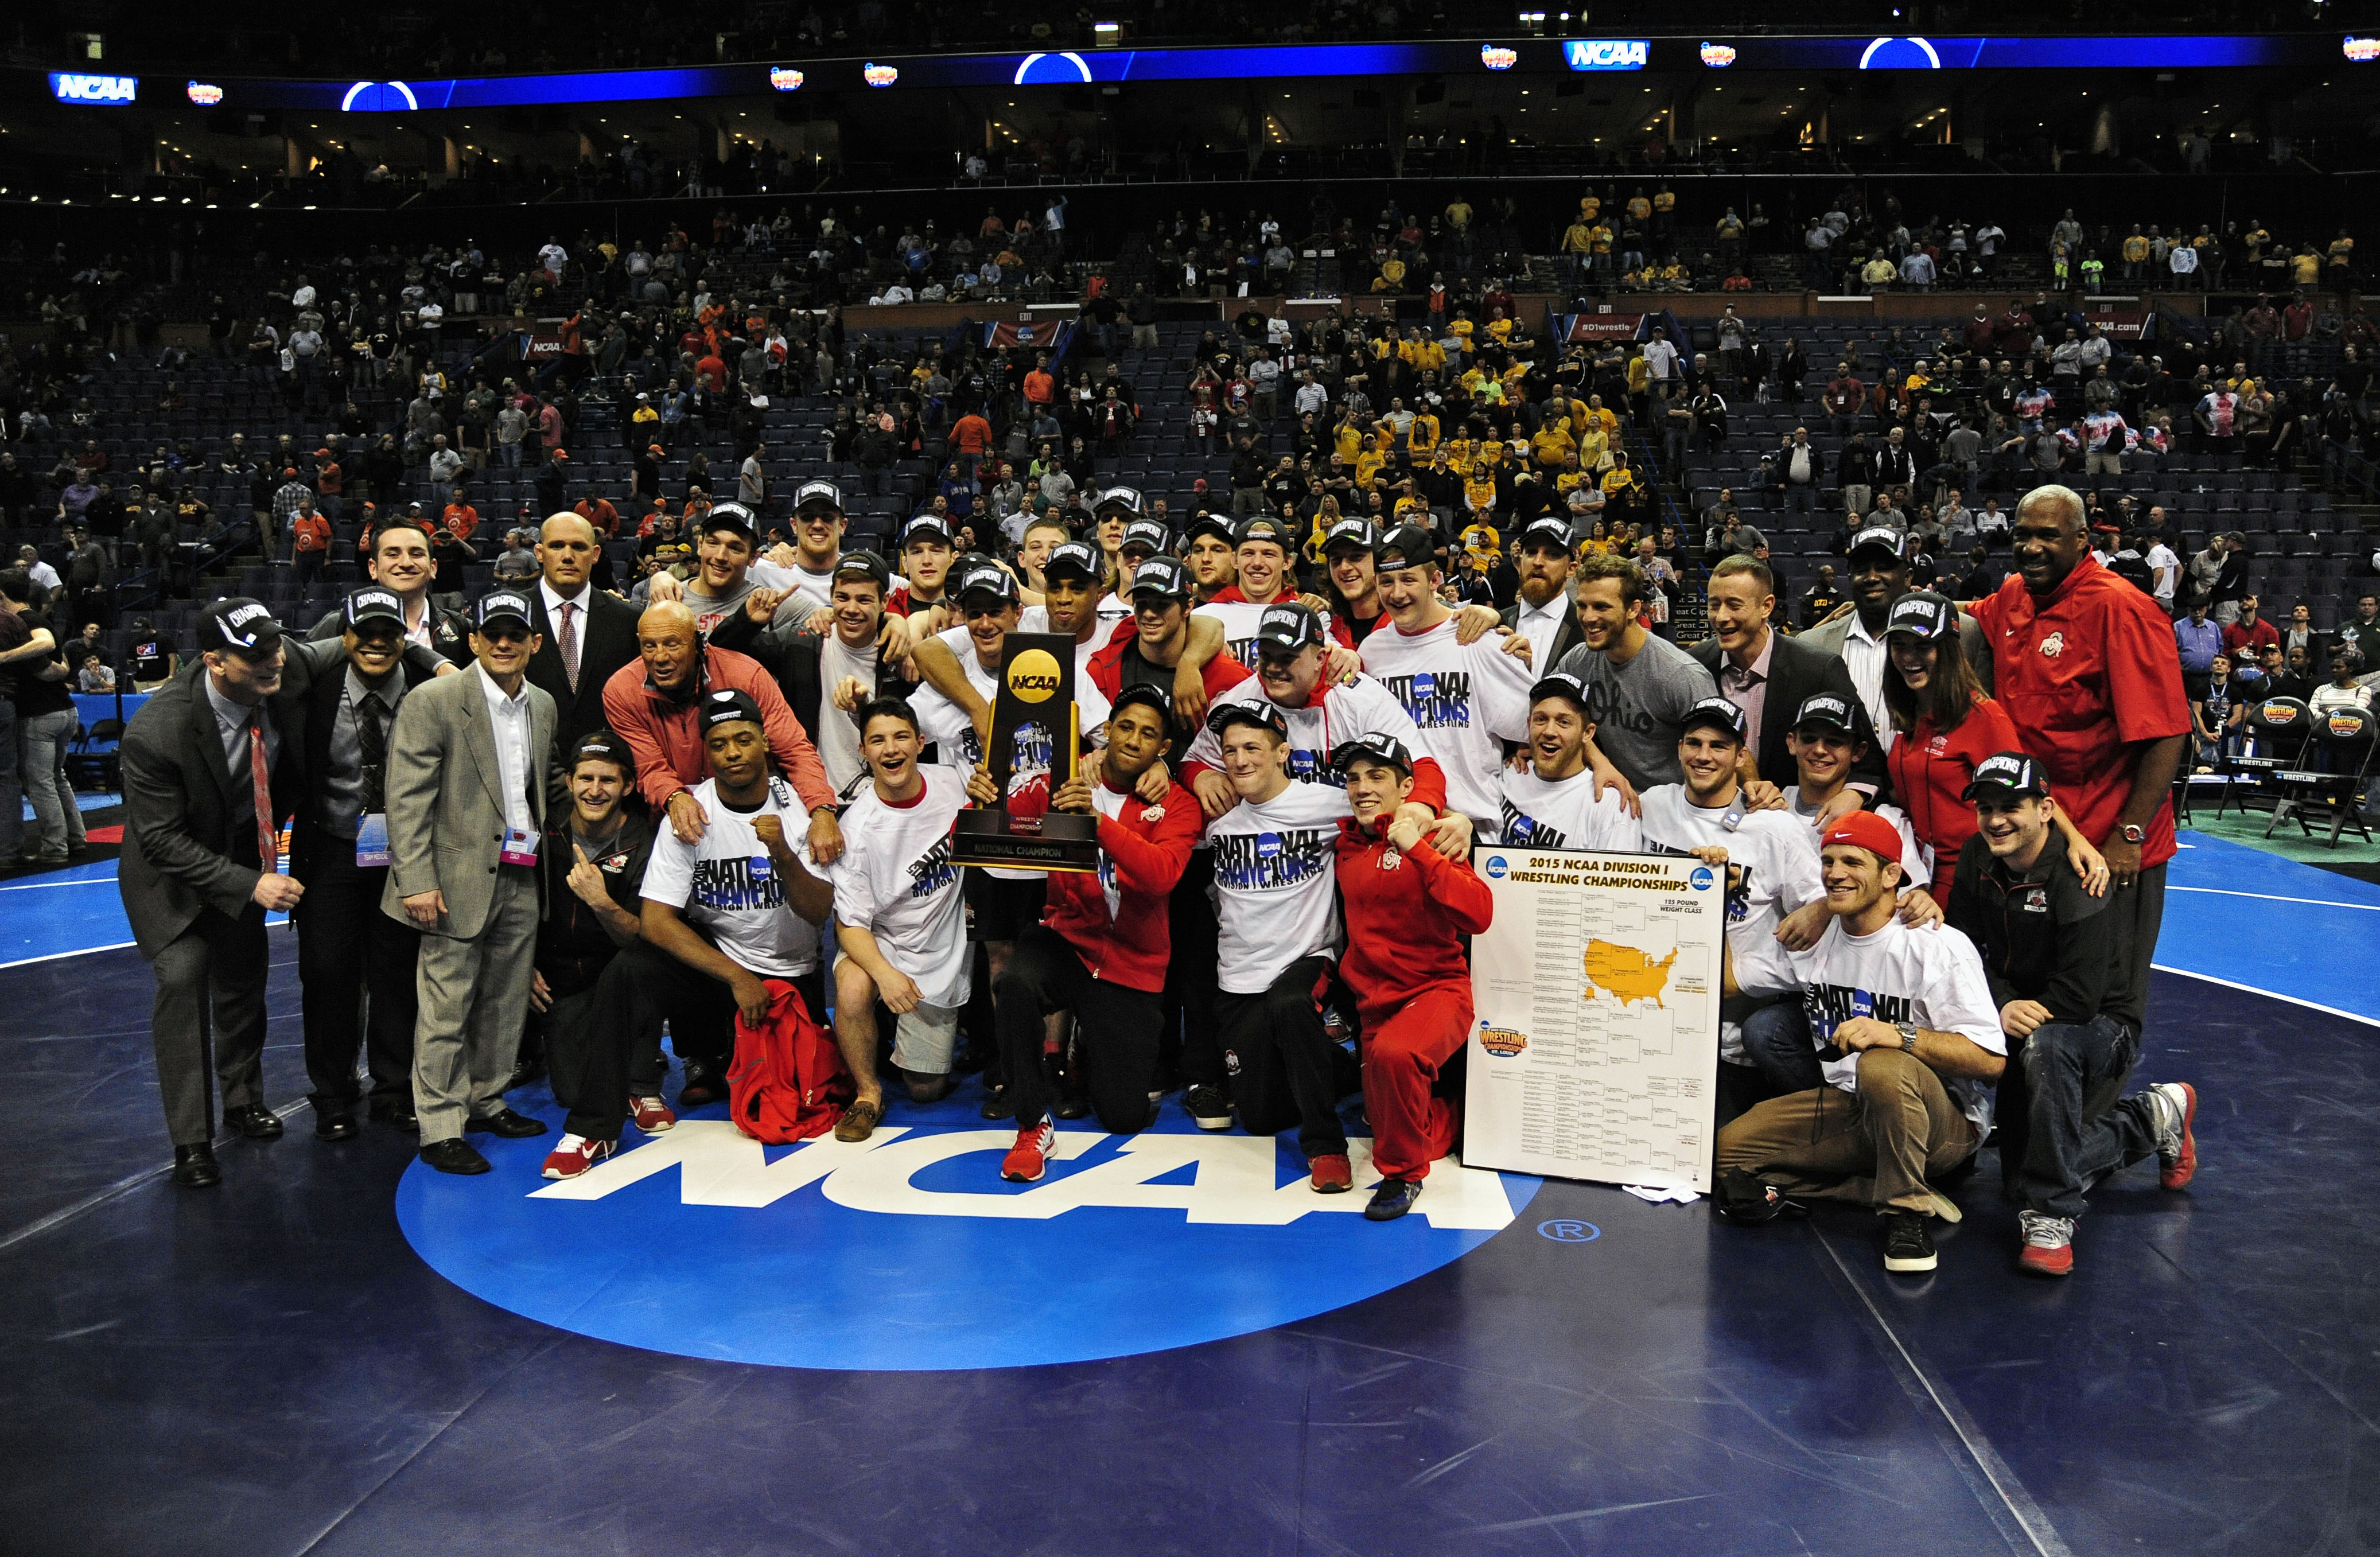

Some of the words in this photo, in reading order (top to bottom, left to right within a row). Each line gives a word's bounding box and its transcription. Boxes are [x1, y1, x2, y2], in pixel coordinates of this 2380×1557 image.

[1571, 43, 1645, 66] NCAA
[58, 74, 135, 101] NCAA
[1599, 305, 1612, 314] EXIT
[1019, 313, 1032, 321] EXIT
[1582, 324, 1630, 332] #D1wrestle
[357, 592, 396, 609] CHAMPIONS
[485, 595, 526, 612] CHAMPIONS
[1894, 600, 1936, 619] CHAMPIONS
[1676, 631, 1700, 639] Great
[1012, 675, 1057, 691] NCAA
[1414, 684, 1434, 693] NCAA
[1590, 680, 1653, 733] Ohio
[2265, 706, 2297, 716] WRESTLING
[1417, 719, 1470, 730] WRESTLING
[2330, 718, 2363, 728] WRESTLING
[1293, 760, 1314, 768] NCAA
[2238, 758, 2273, 767] WRESTLING
[2283, 773, 2317, 783] WRESTLING
[975, 844, 1014, 855] NATIONAL
[1016, 846, 1061, 858] CHAMPION
[1258, 843, 1281, 852] NCAA
[751, 867, 771, 875] NCAA
[1488, 866, 1508, 874] NCAA
[1530, 857, 1560, 869] 2015
[1564, 859, 1599, 871] NCAA
[1603, 862, 1661, 874] DIVISION
[1664, 865, 1669, 875] I
[1262, 865, 1324, 889] WRESTLING
[1510, 871, 1579, 886] WRESTLING
[1583, 875, 1688, 892] CHAMPIONSHIPS
[1692, 878, 1713, 887] NCAA
[1479, 1030, 1527, 1048] WRESTLING
[1484, 1043, 1522, 1053] CHAMPIONSHIPS
[526, 1120, 1516, 1230] NCAA
